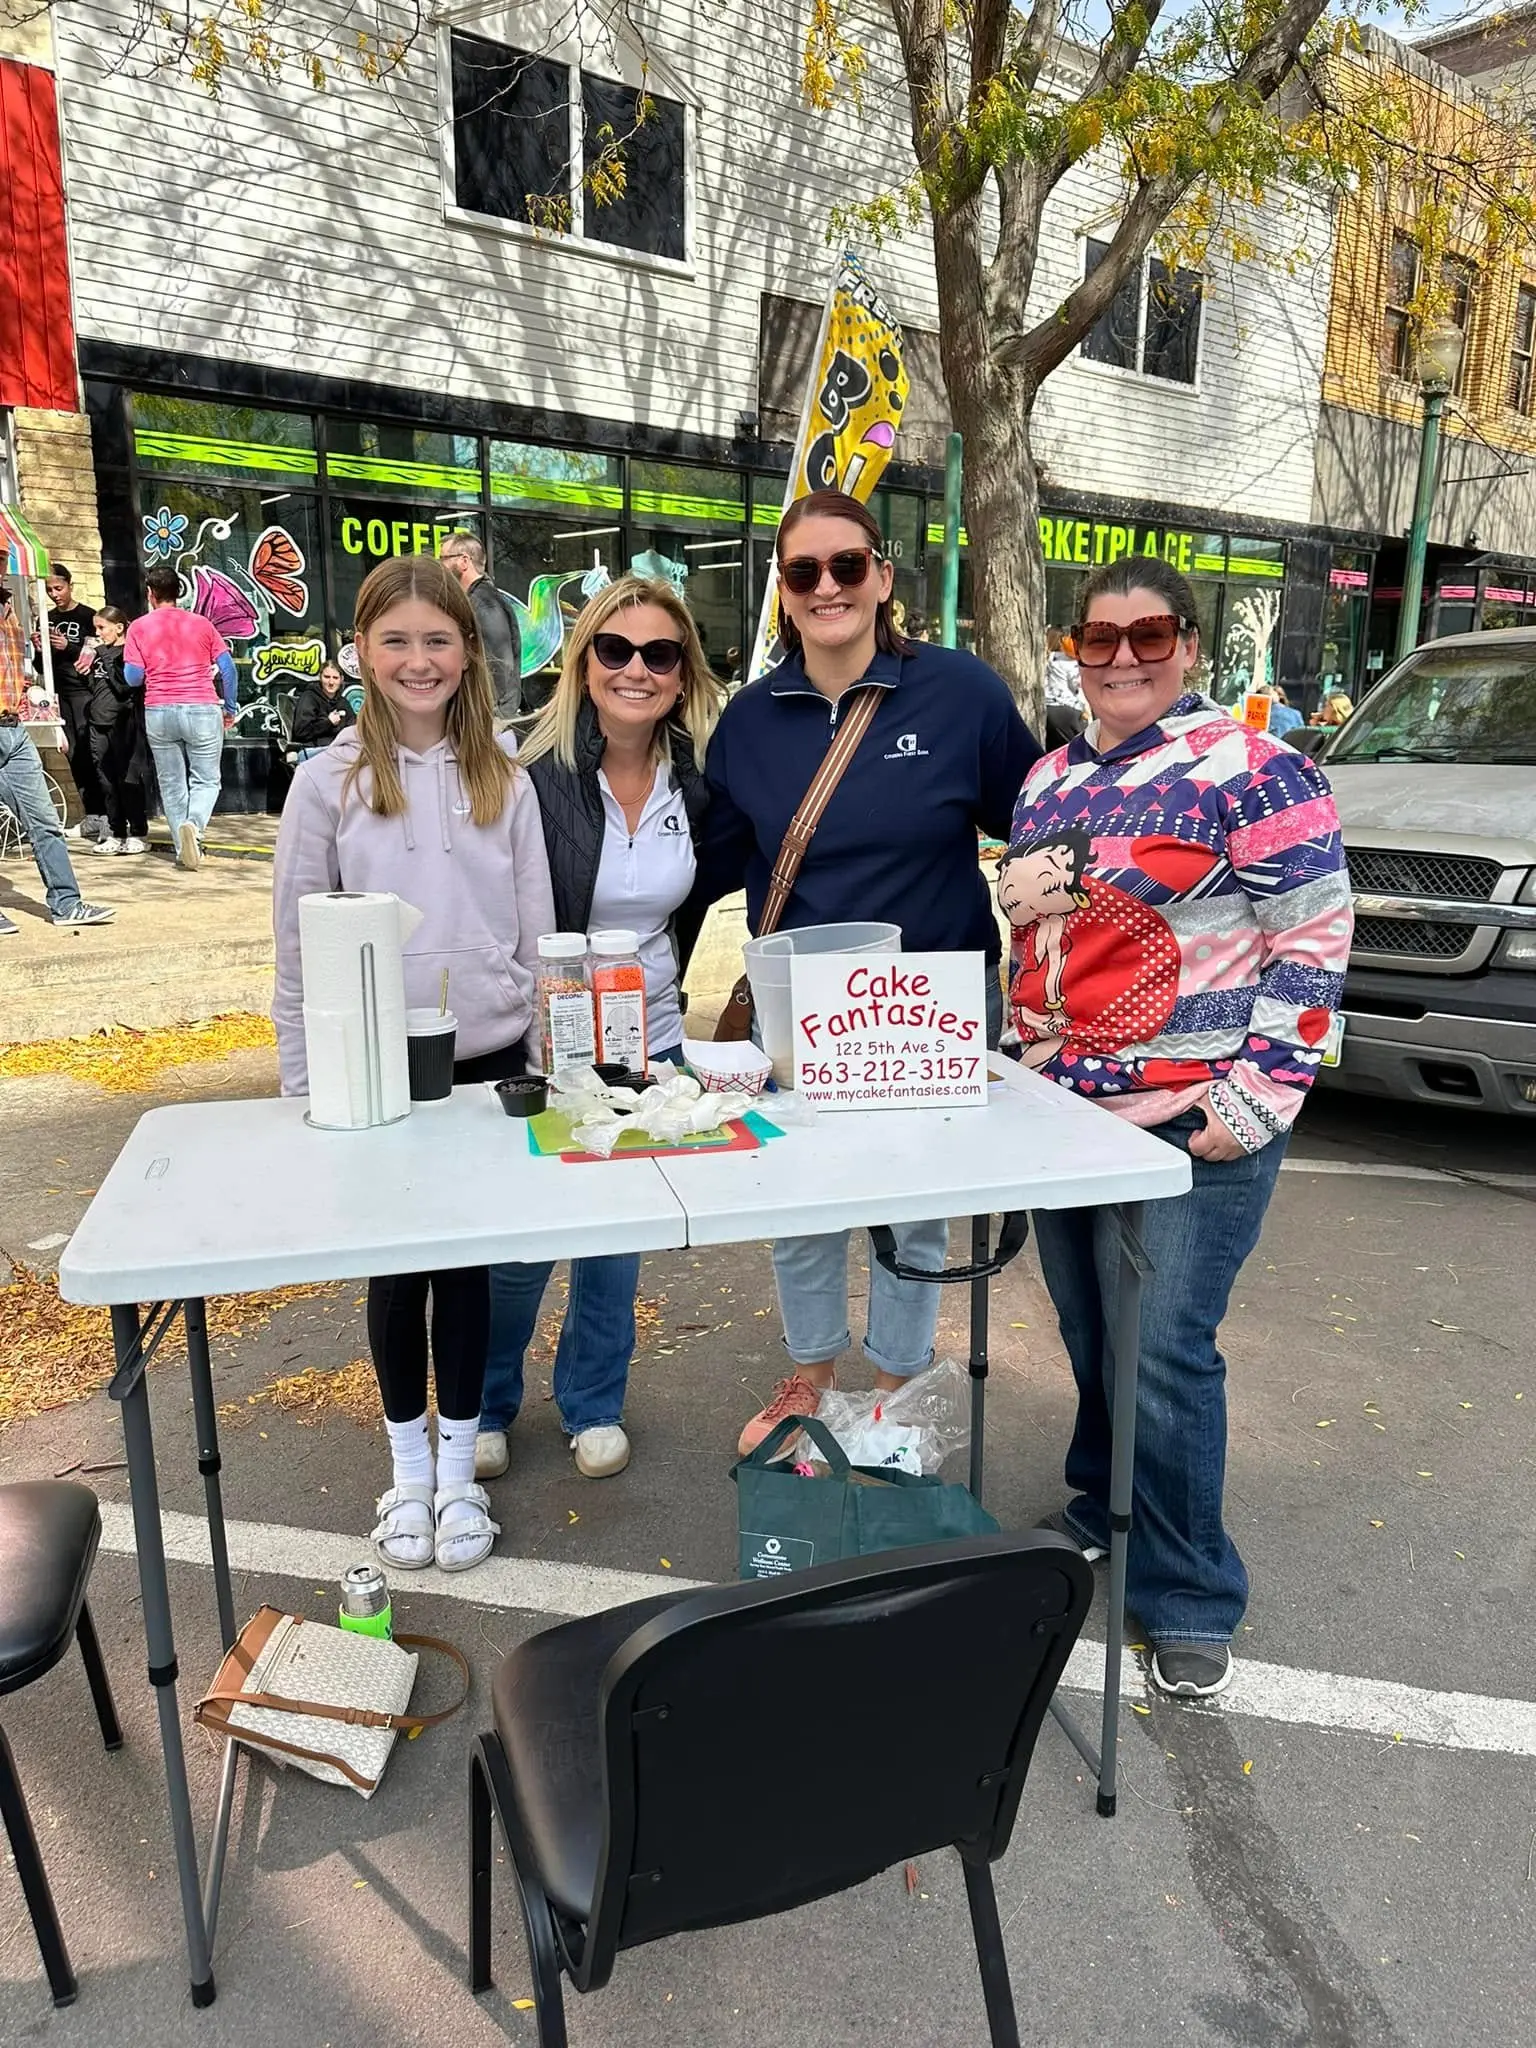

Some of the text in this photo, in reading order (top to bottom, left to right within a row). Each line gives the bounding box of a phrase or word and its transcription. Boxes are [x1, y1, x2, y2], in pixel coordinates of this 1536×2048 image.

[1038, 517, 1193, 573] RKETPLACE
[846, 965, 931, 998] Cake
[800, 999, 979, 1049] Fantasies
[836, 1039, 945, 1056] 122 5th Ave S
[802, 1057, 980, 1085] 563-212-3157
[803, 1084, 981, 1102] www.mycakefantasies.com
